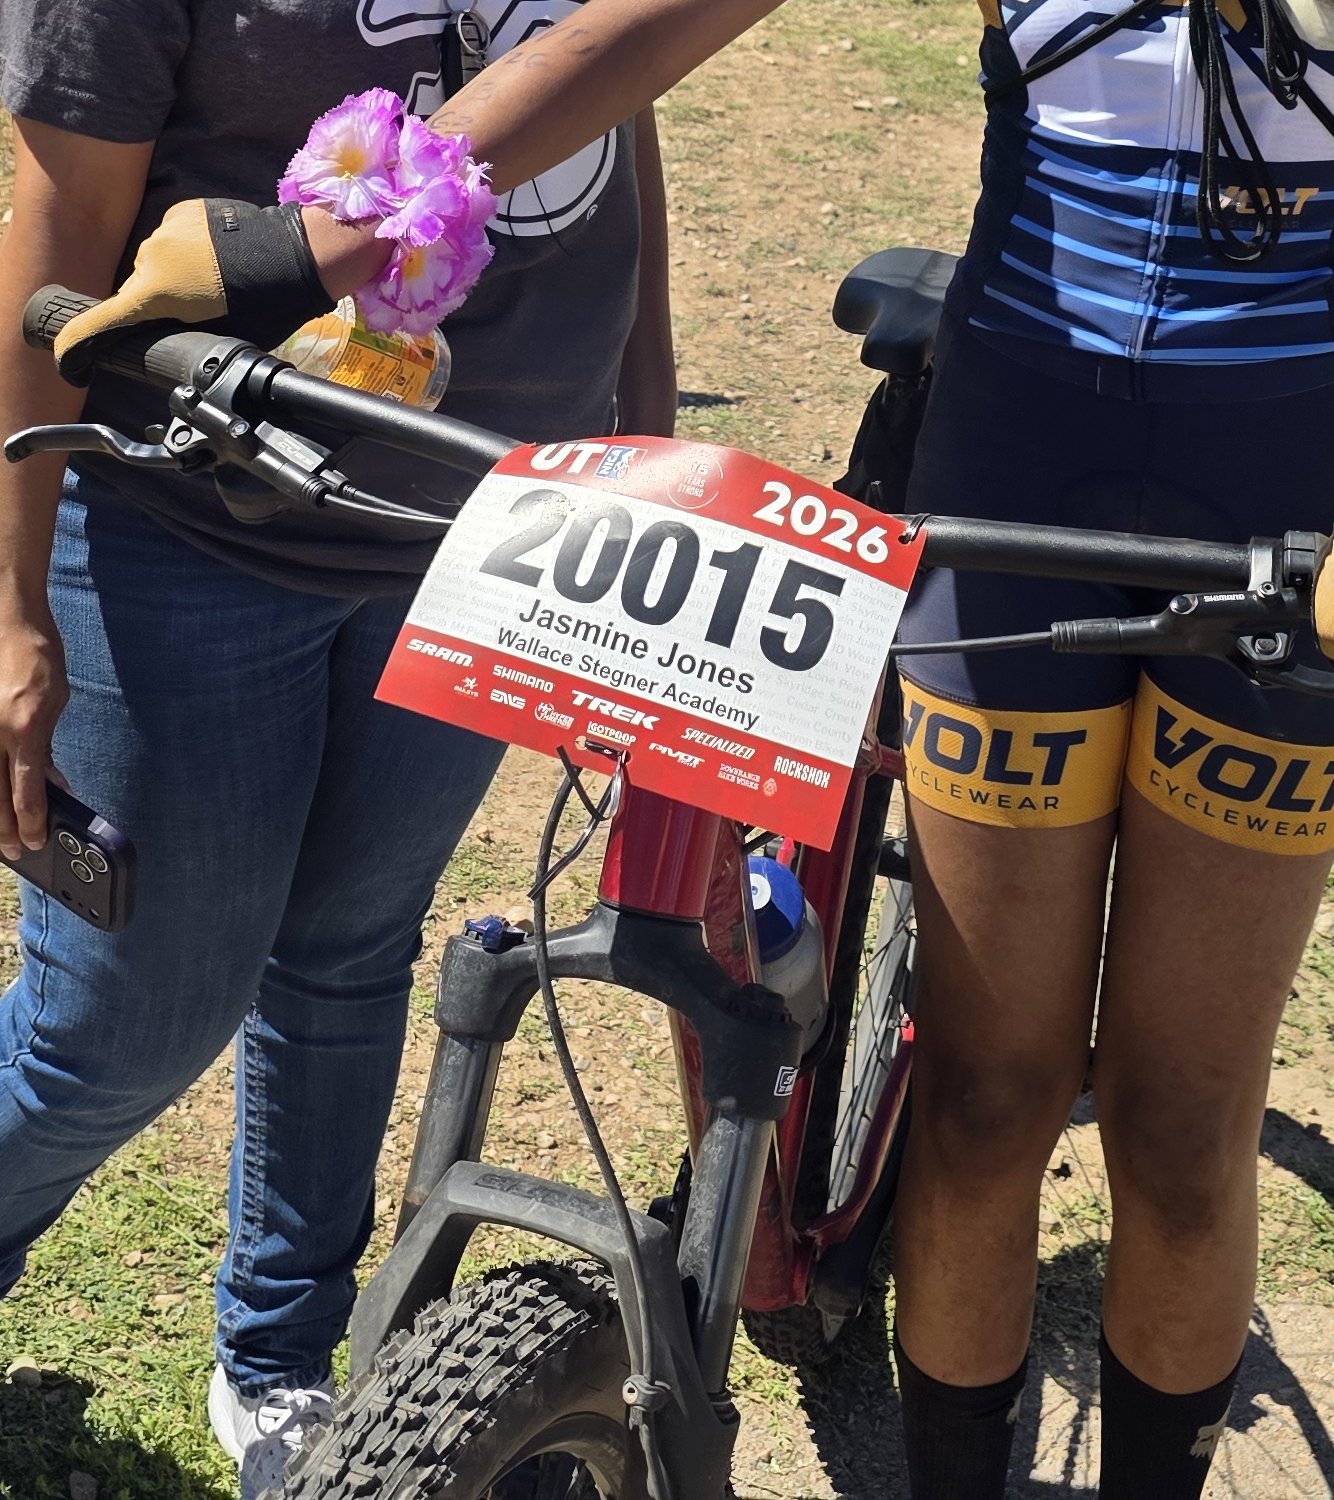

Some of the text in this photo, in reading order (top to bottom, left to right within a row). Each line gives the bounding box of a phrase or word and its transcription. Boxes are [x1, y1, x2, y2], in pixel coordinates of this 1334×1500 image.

[530, 442, 608, 475] UT
[752, 481, 889, 564] 2026
[478, 488, 849, 672] 20015
[406, 638, 474, 668] SRAM
[519, 599, 755, 694] Jasmine Jones
[492, 664, 554, 694] SHIMANO
[498, 627, 761, 731] Wallace Stegner Academy
[571, 690, 660, 731] TREK
[648, 742, 706, 765] PIVOT
[681, 727, 756, 760] SPECIALIZED
[773, 755, 831, 789] ROCKSHOX
[1149, 769, 1328, 838] CYCLEWEAR
